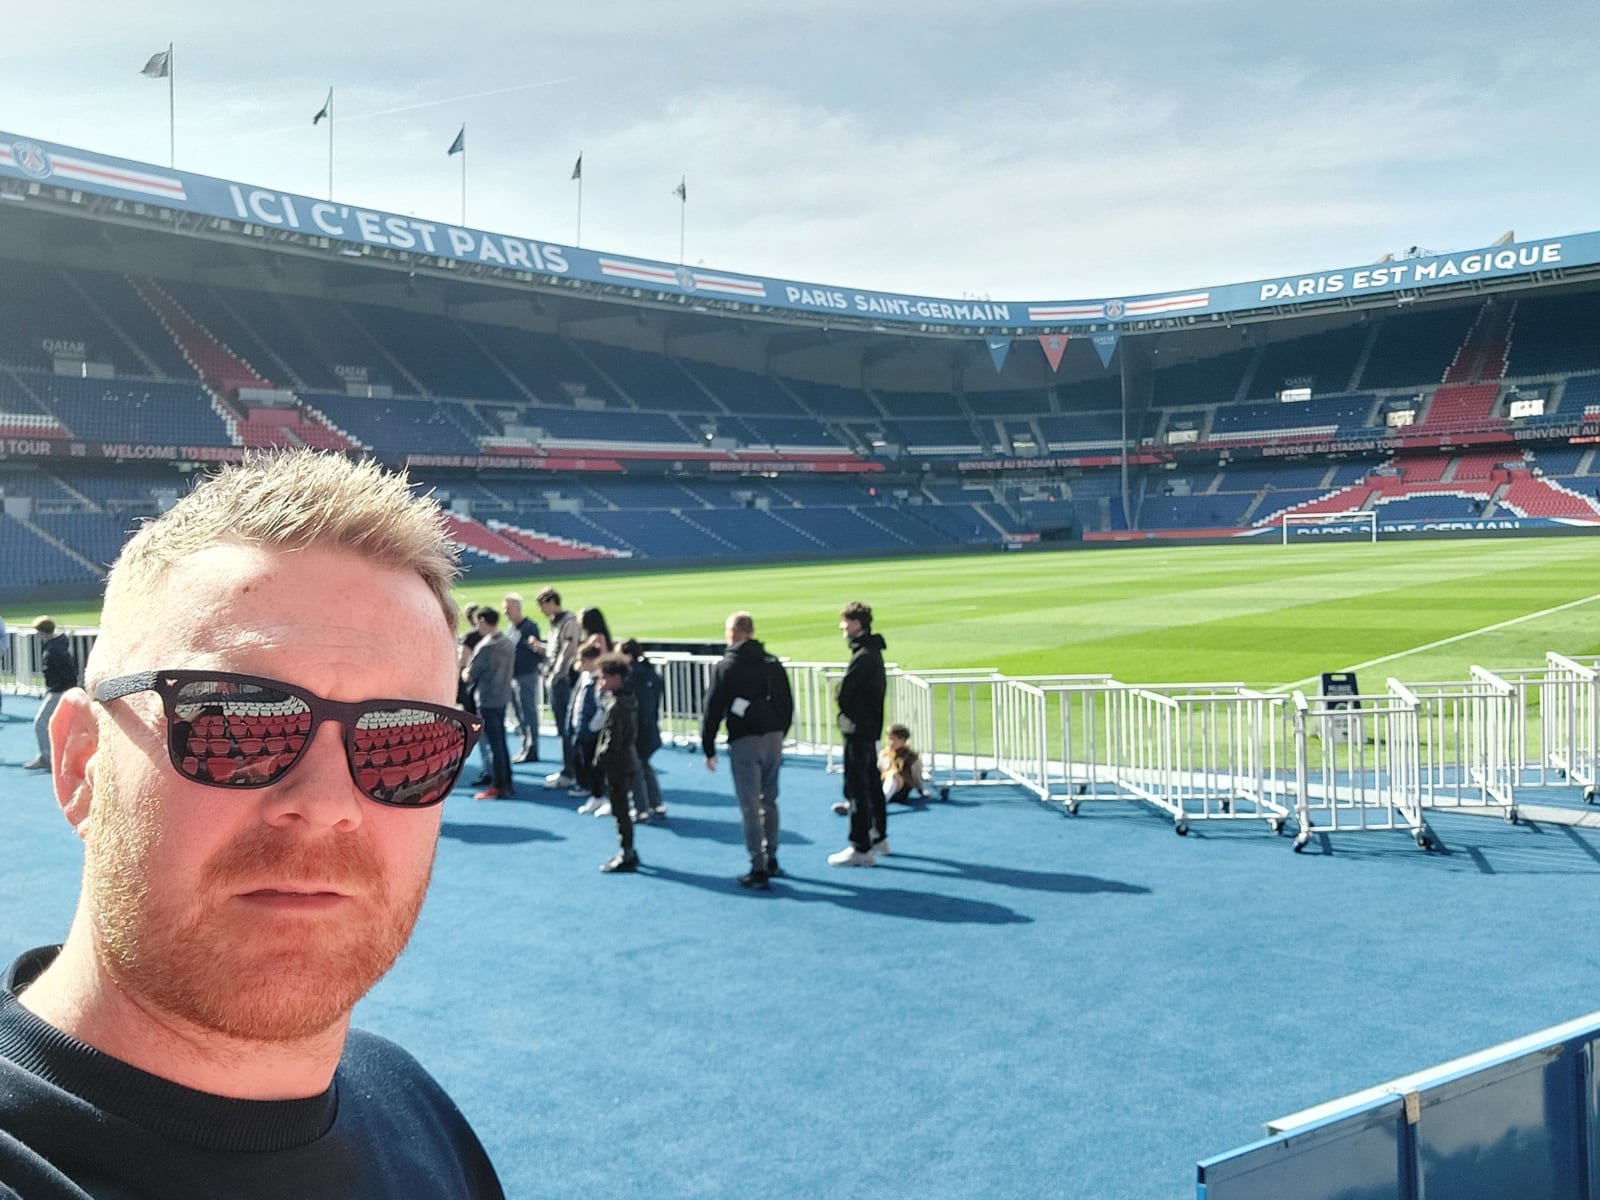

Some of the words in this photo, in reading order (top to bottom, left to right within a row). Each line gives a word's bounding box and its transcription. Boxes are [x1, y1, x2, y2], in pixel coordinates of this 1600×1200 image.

[229, 185, 299, 228] ICI
[311, 202, 437, 253] C'EST
[447, 227, 569, 273] PARIS
[1260, 274, 1344, 301] PARIS
[1352, 266, 1408, 290] EST
[1414, 243, 1562, 281] MAGIQUE
[785, 286, 848, 309] PARIS
[854, 295, 1010, 321] SAINT-GERMAIN
[1514, 426, 1579, 440] BIENVENUE
[1582, 424, 1599, 436] AU
[9, 440, 50, 455] TOUR
[103, 443, 177, 459] WELCOME
[180, 446, 200, 460] TO
[1263, 444, 1313, 456] BIENVENUE
[1315, 443, 1329, 453] AU
[1330, 441, 1375, 452] STADIUM
[1377, 439, 1403, 449] TOUR
[1016, 458, 1055, 469] STADIUM
